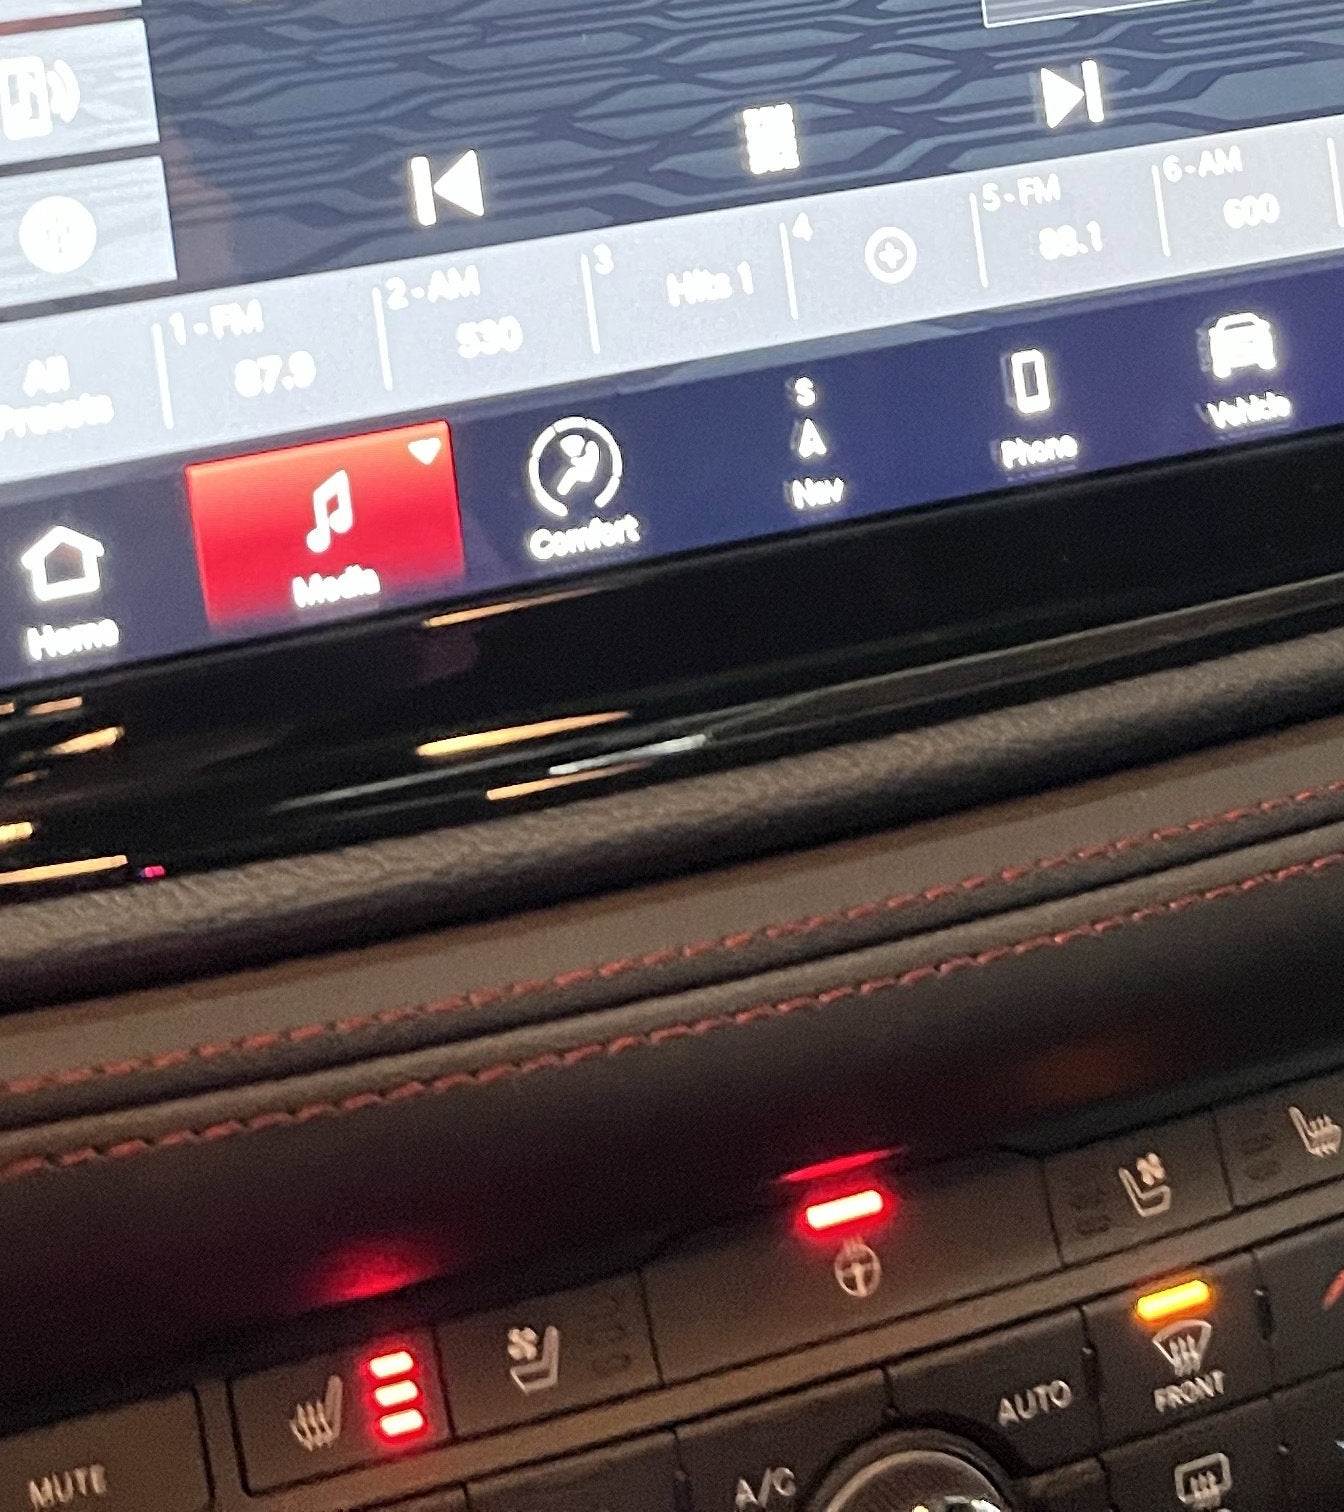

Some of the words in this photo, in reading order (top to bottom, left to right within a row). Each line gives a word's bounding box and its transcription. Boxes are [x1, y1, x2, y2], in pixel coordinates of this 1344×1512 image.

[1205, 391, 1293, 430] Vehicle
[1000, 433, 1079, 470] Phone
[791, 476, 845, 510] Nav
[528, 512, 641, 560] Comfort
[291, 563, 382, 610] Media
[26, 618, 120, 662] Home
[996, 1379, 1074, 1427] AUTO
[1153, 1369, 1226, 1414] FRONT
[28, 1463, 107, 1512] MUTE
[734, 1466, 797, 1512] A/C
